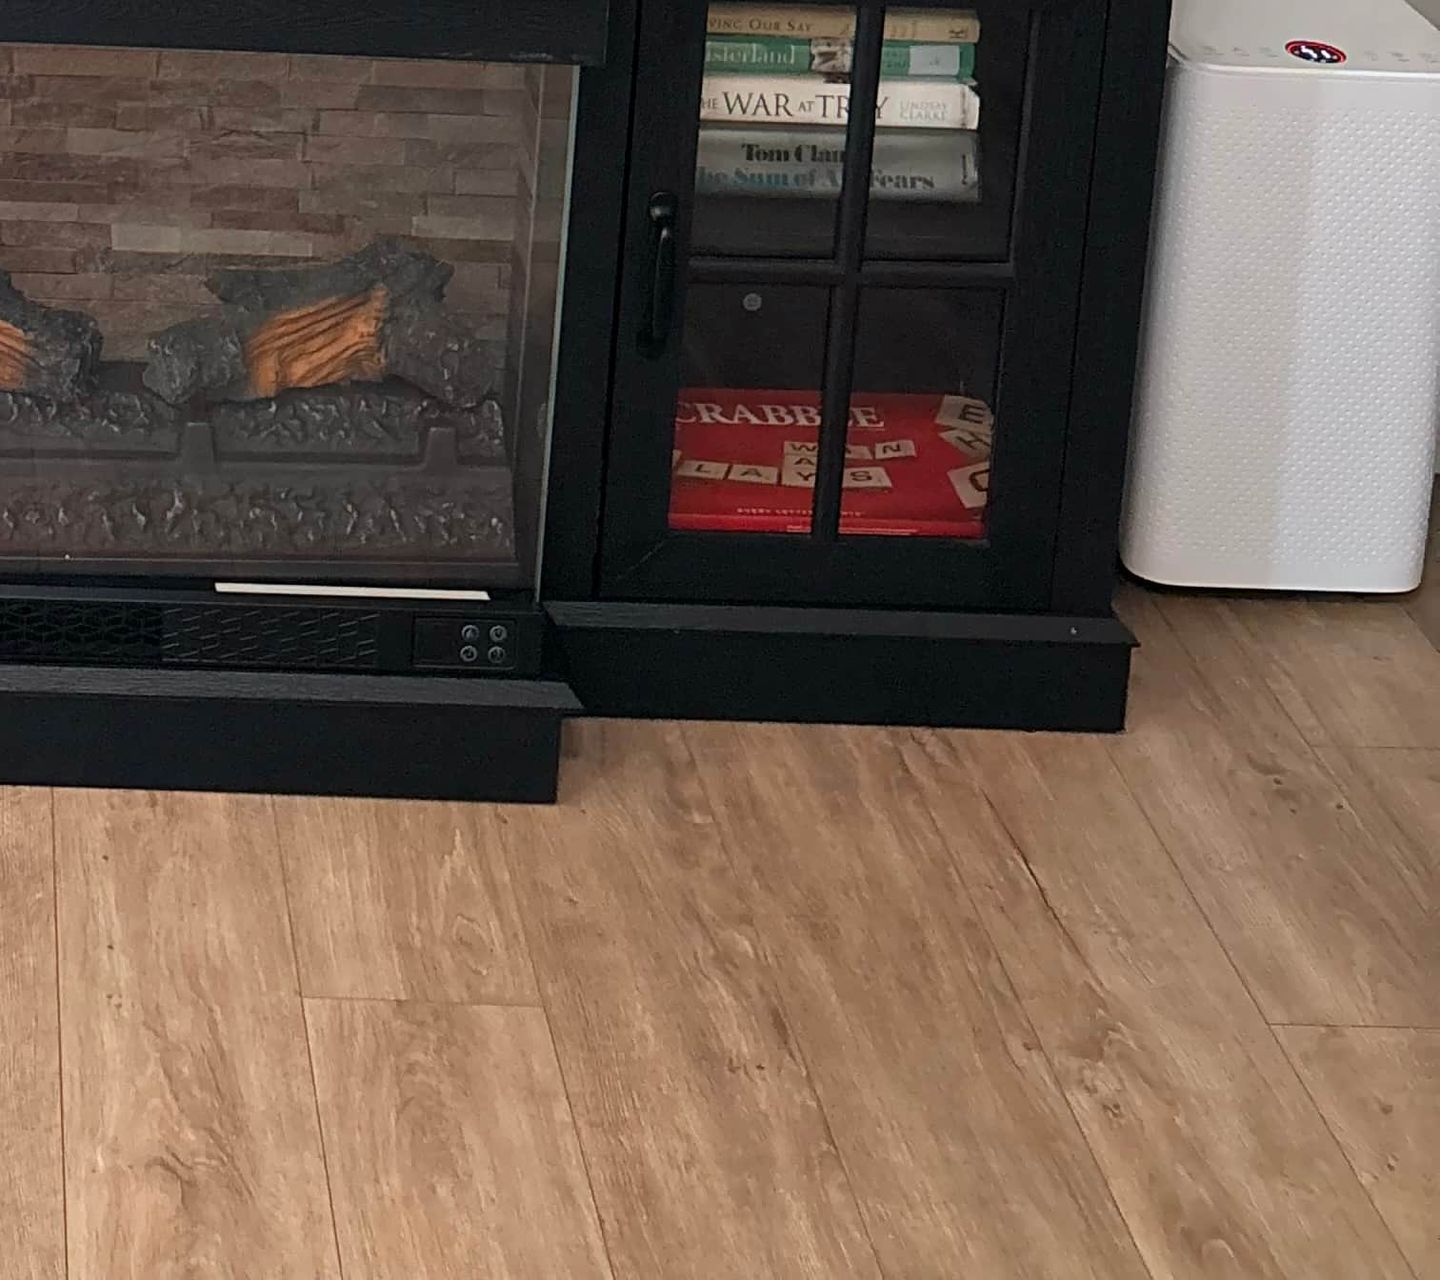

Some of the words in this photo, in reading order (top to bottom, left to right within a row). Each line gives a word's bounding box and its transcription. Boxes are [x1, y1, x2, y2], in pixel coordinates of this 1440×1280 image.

[701, 97, 718, 111] HE
[722, 91, 793, 117] WAR
[798, 100, 816, 113] AT
[815, 93, 888, 121] TRY
[742, 143, 790, 162] Tom
[675, 401, 885, 429] CRABBE
